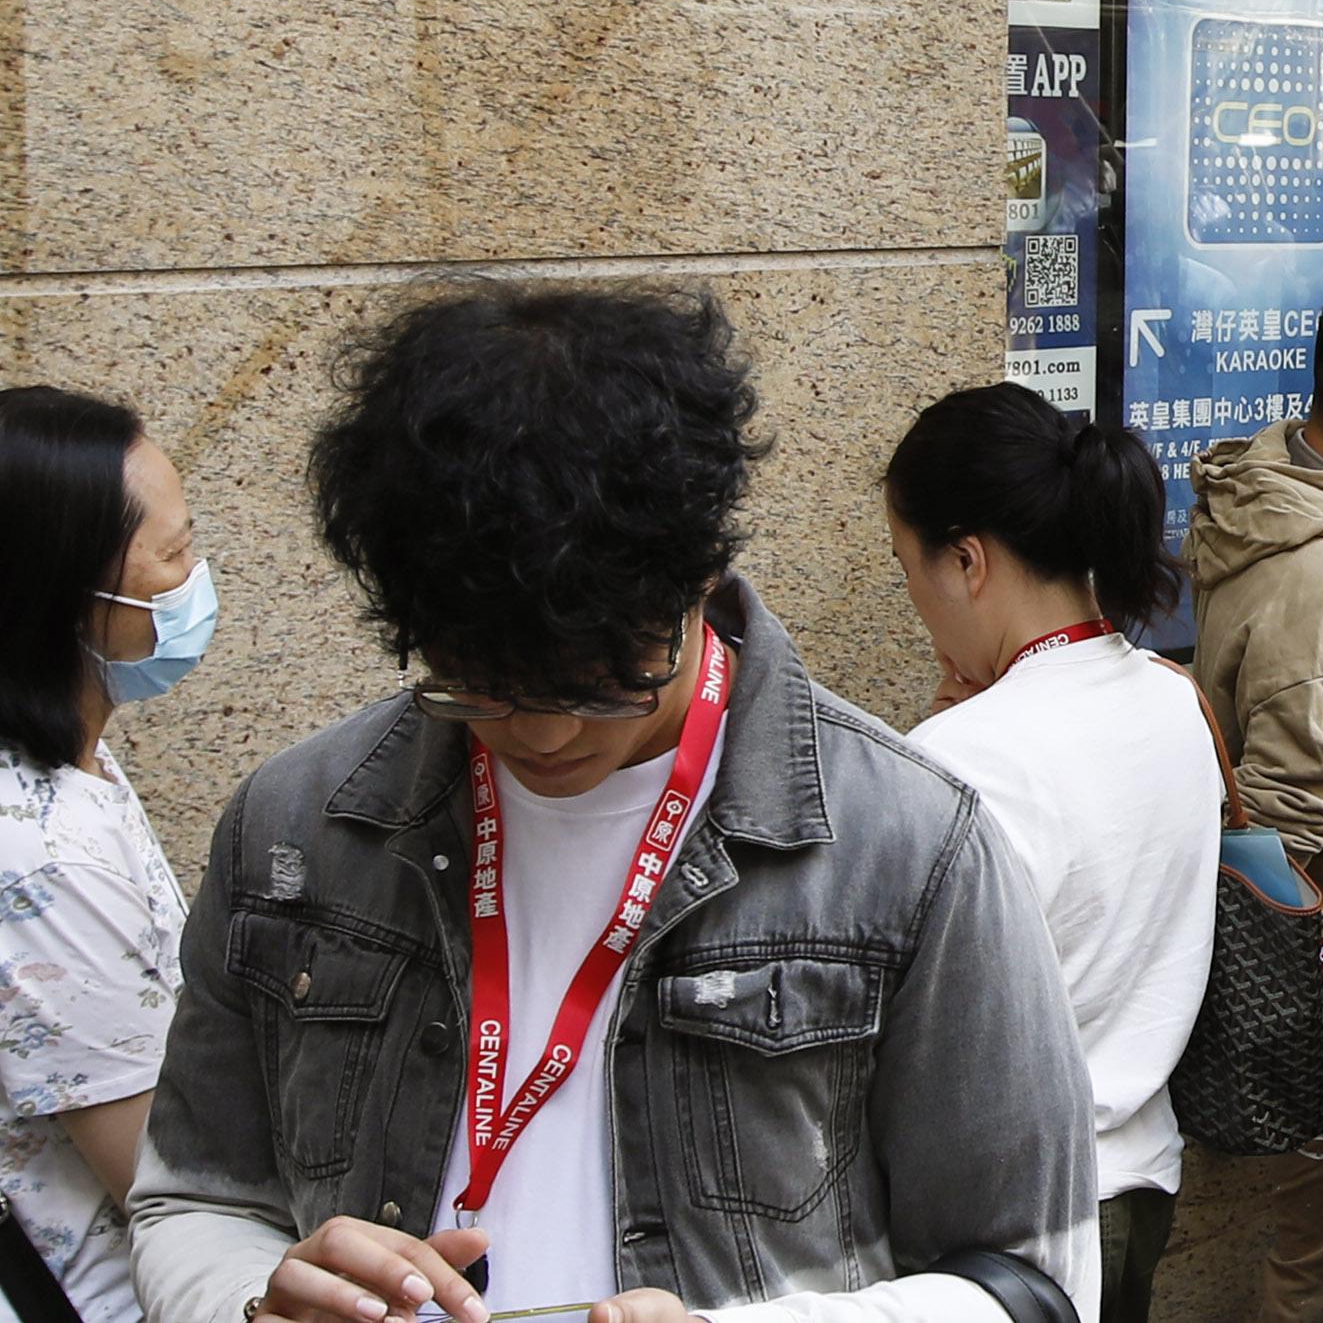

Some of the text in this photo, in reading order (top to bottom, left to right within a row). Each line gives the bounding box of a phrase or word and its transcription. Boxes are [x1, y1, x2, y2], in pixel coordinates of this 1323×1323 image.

[1213, 101, 1316, 147] CEO
[1009, 313, 1081, 335] 9262 1888
[1190, 308, 1320, 344] 灣仔英皇CE
[1215, 348, 1307, 373] KARAOKE
[1049, 386, 1079, 403] 1133
[1167, 439, 1178, 459] &
[473, 816, 499, 919] 中原地產
[602, 851, 663, 955] 中原地產
[475, 1019, 501, 1147] CENTALINE
[491, 1043, 573, 1152] CENTALINE
